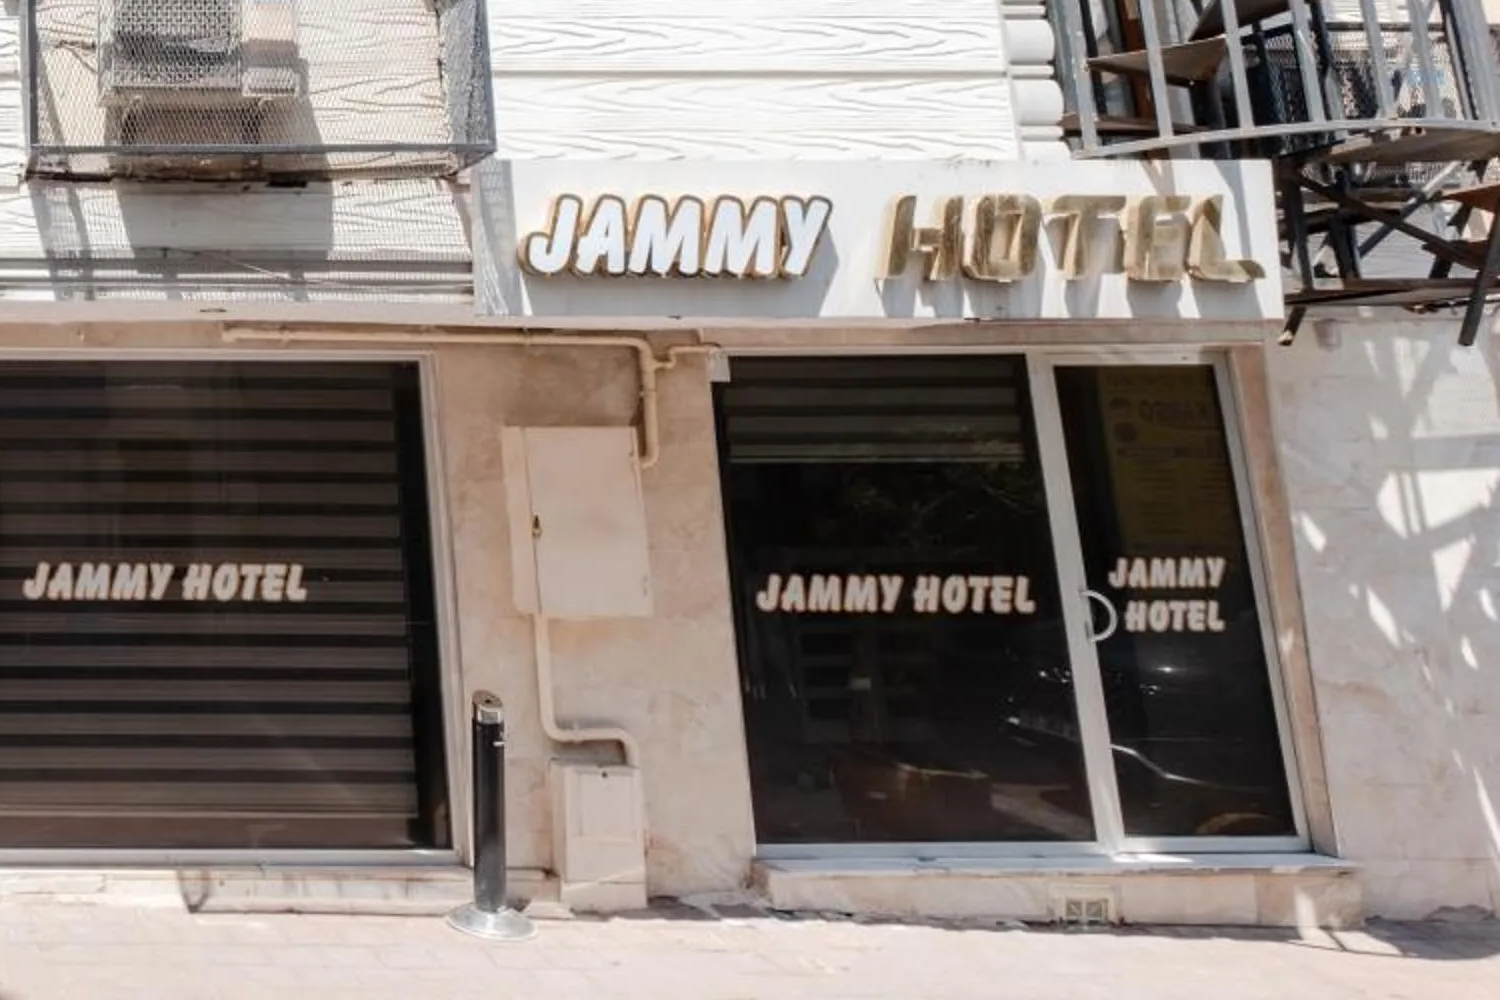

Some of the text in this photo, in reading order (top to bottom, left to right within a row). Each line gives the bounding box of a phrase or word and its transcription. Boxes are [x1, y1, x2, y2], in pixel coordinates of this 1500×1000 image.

[517, 193, 1267, 283] JAMMY HOTEL
[22, 561, 308, 602] JAMMY HOTEL
[756, 573, 1037, 615] JAMMY HOTEL
[1108, 558, 1225, 589] JAMMY
[1124, 600, 1225, 632] HOTEL
